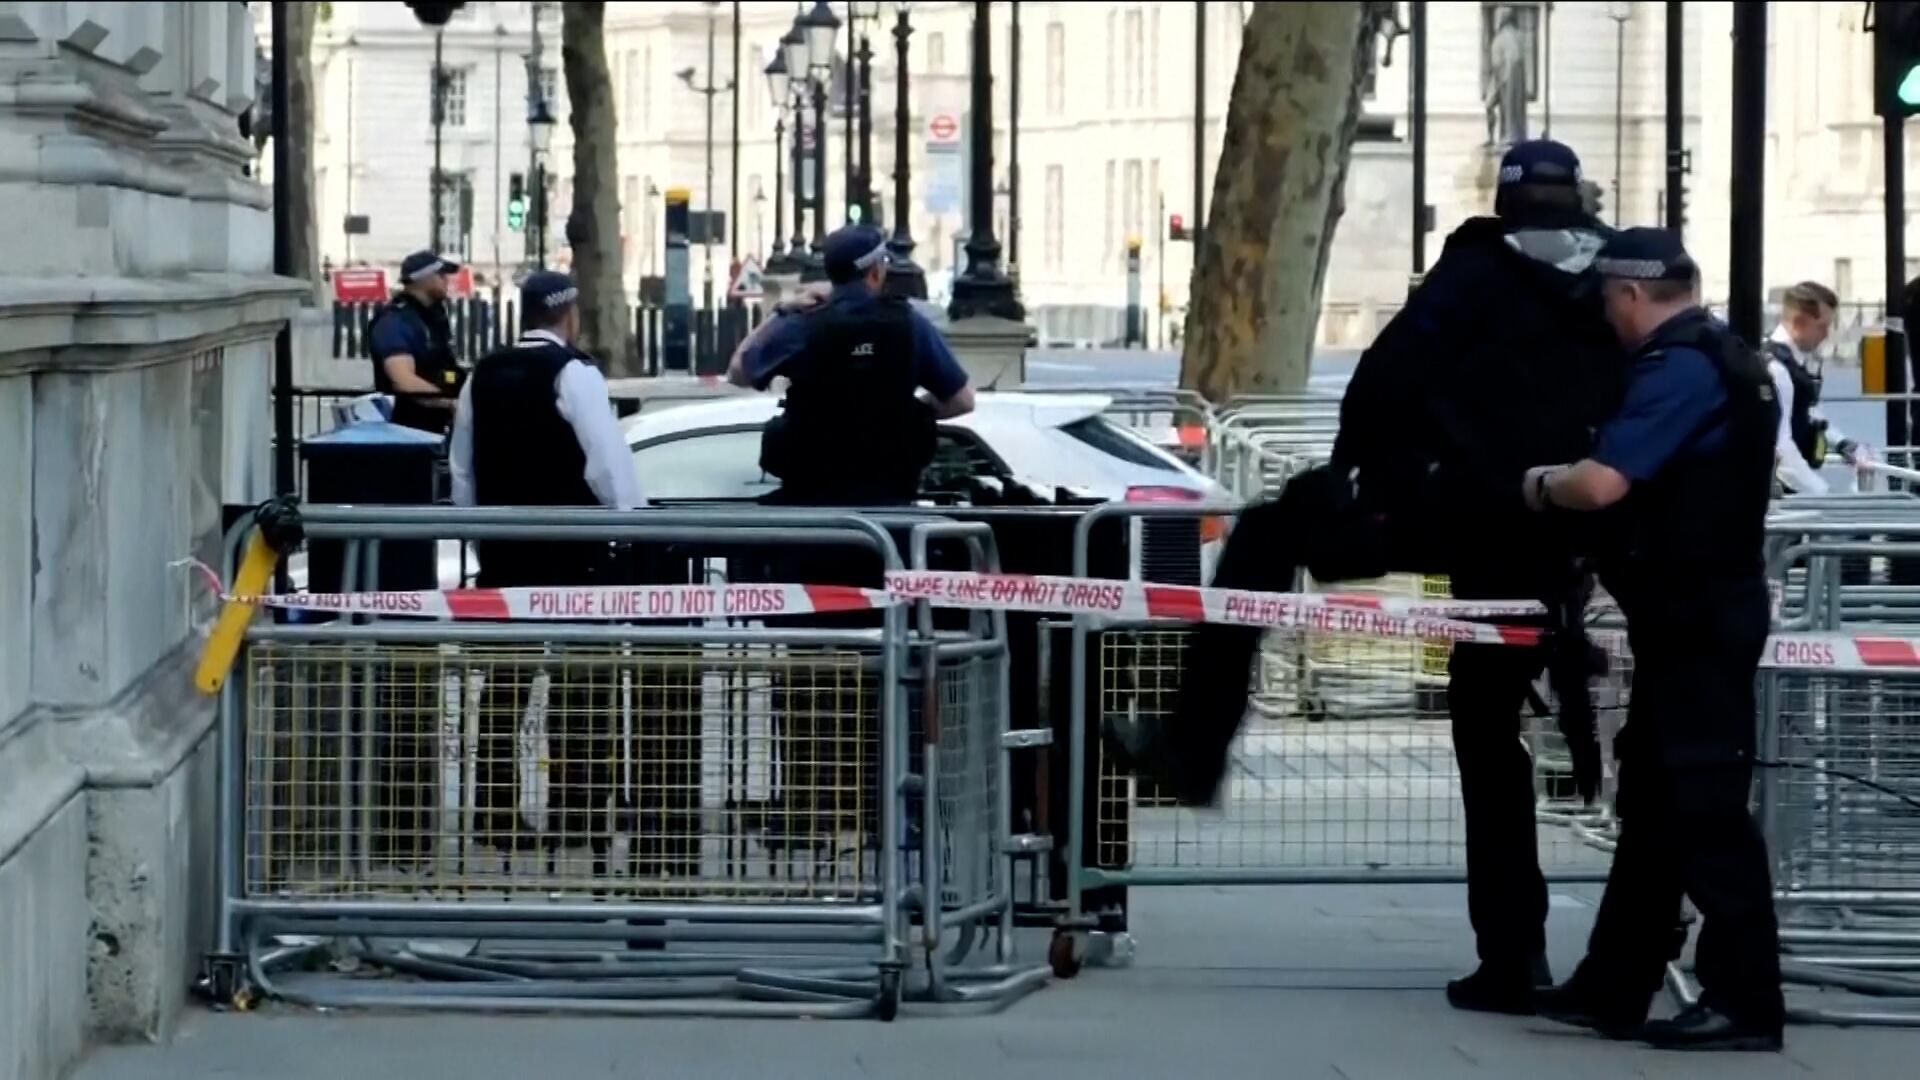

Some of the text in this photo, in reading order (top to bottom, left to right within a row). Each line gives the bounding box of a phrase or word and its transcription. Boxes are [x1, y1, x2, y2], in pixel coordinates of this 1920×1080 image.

[316, 594, 351, 609] NOT
[360, 592, 422, 611] CROSS
[529, 588, 785, 615] POLICE LINE DO NOT CROSS
[947, 578, 988, 600] LINE
[992, 580, 1017, 602] DO
[1021, 581, 1058, 604] NOT
[1062, 583, 1124, 610] CROSS
[1224, 596, 1289, 625] POLICE
[1295, 606, 1334, 630] LINE
[1341, 609, 1366, 632] DO
[1373, 613, 1406, 636] NOT
[1775, 641, 1835, 664] CROSS
